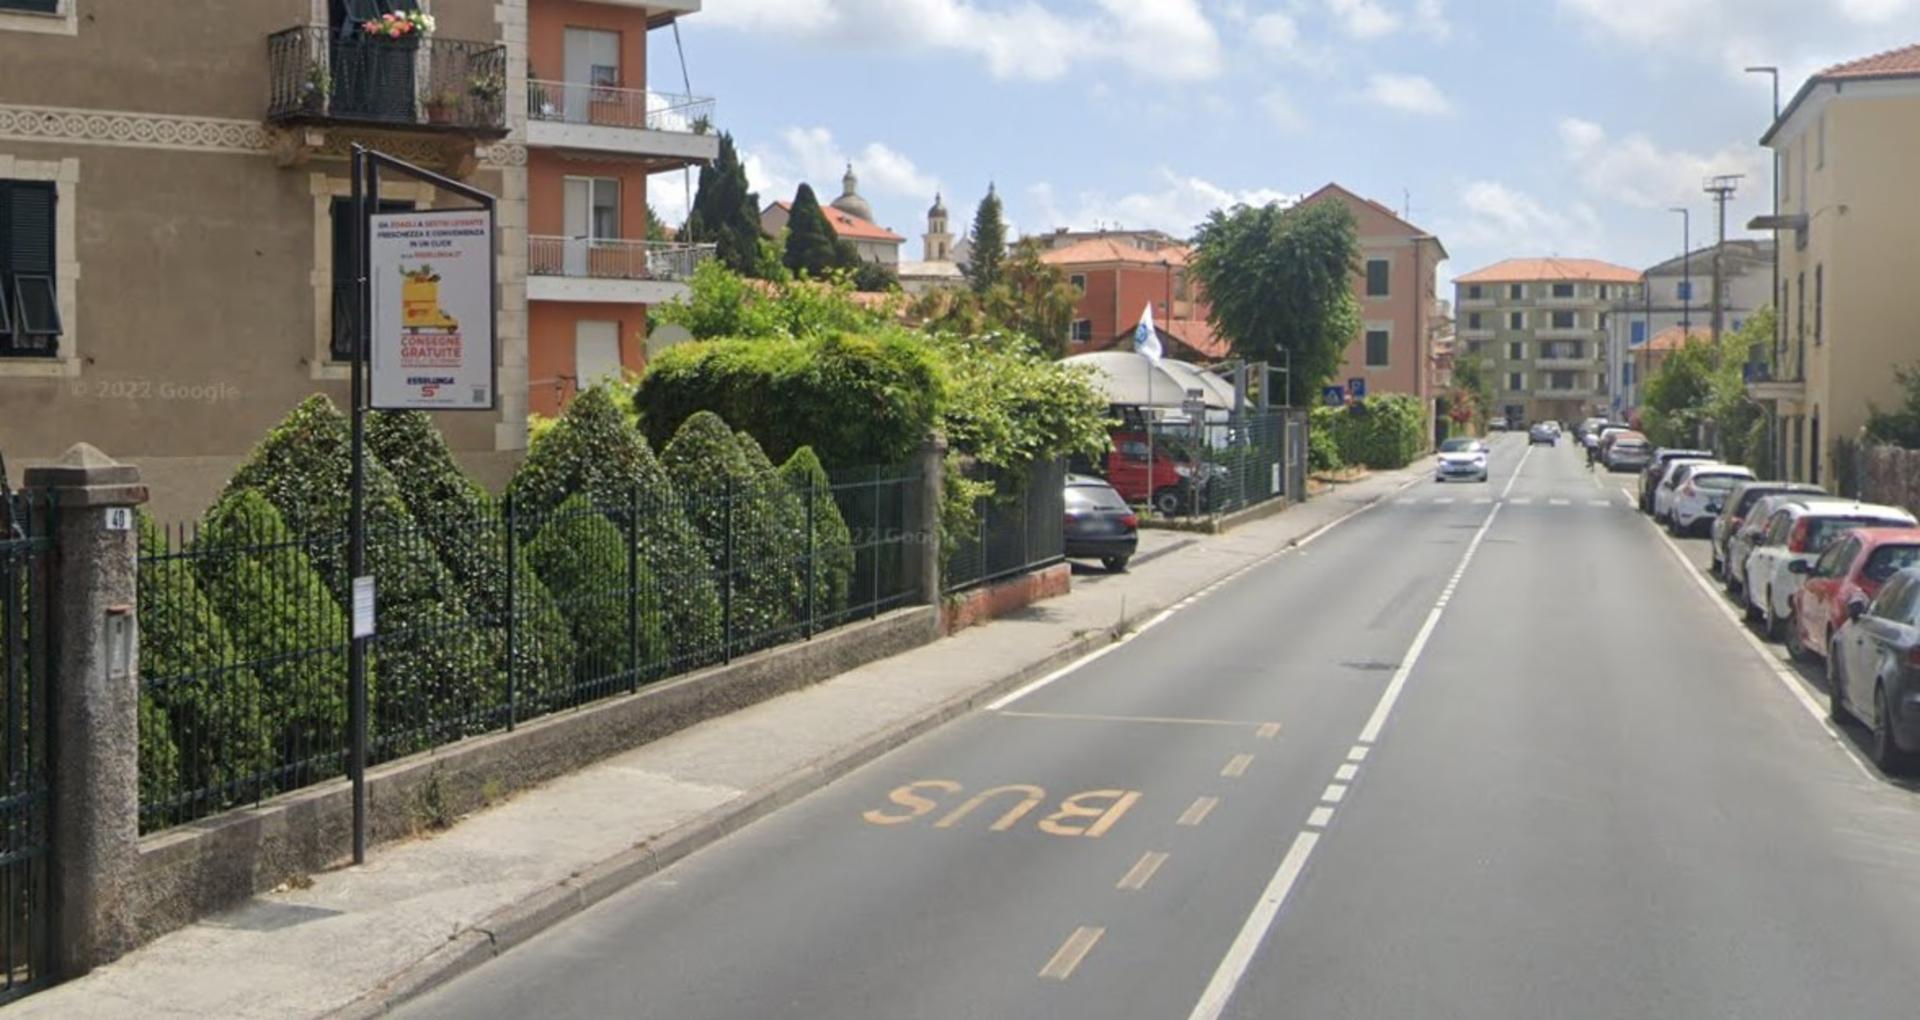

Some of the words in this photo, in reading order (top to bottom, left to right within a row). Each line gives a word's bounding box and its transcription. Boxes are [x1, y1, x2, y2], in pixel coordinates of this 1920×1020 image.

[401, 336, 460, 346] CONSEGNE
[401, 347, 461, 358] GRATUITE
[862, 779, 1143, 837] BUS
